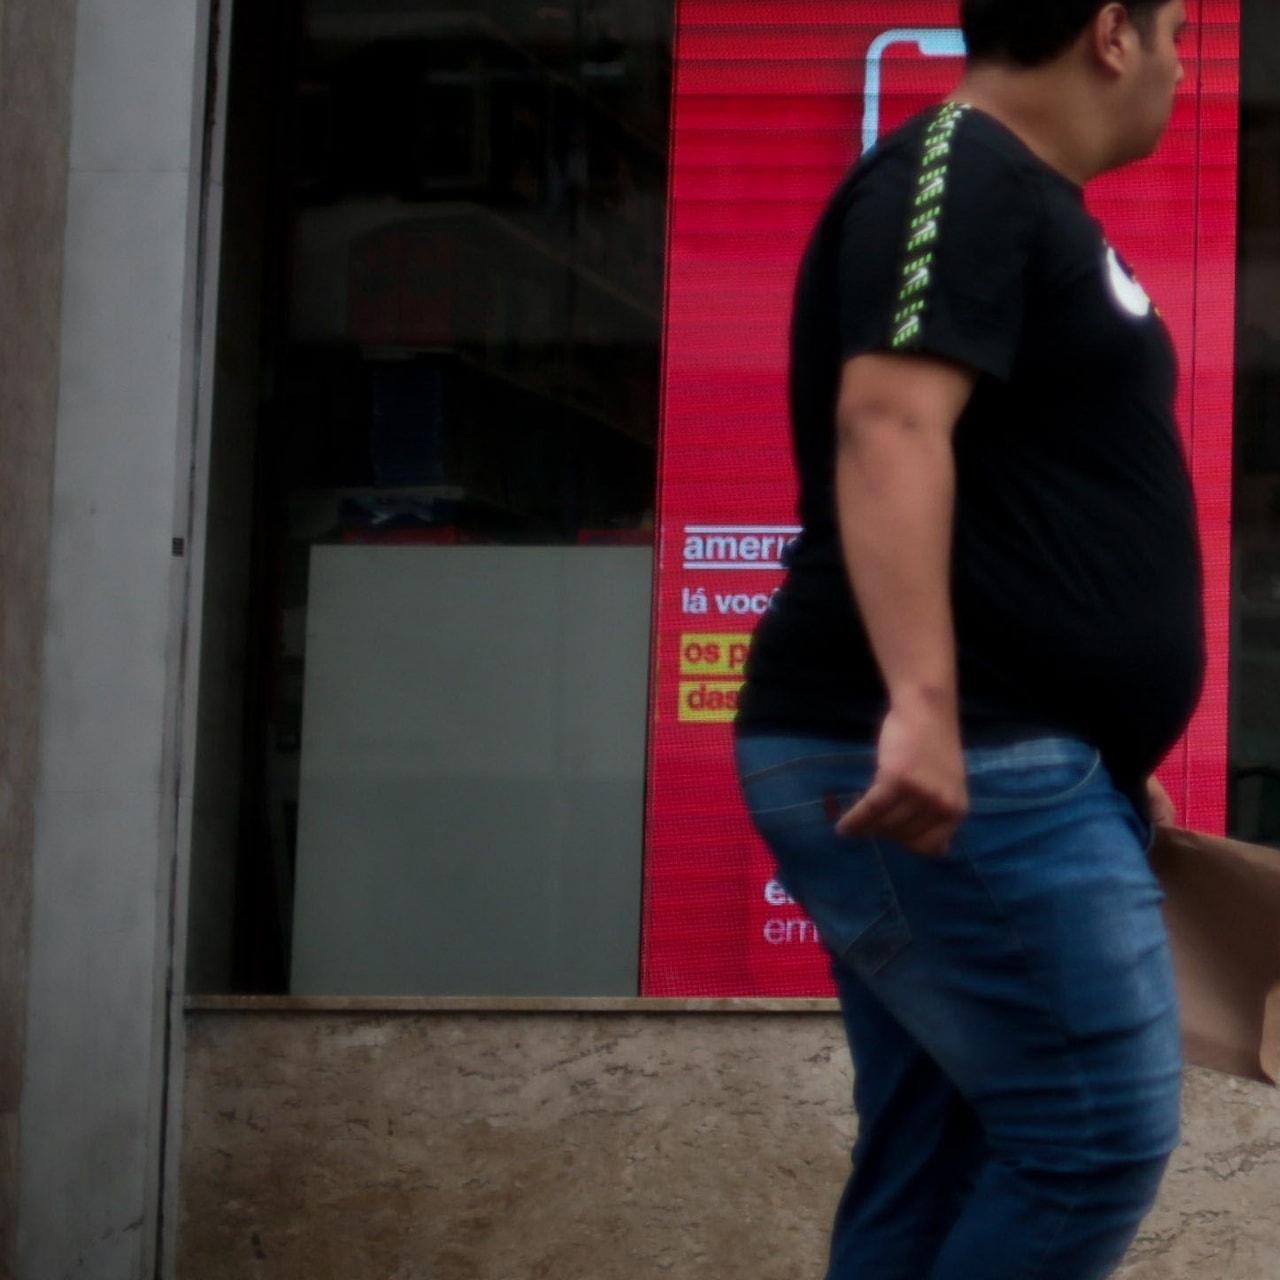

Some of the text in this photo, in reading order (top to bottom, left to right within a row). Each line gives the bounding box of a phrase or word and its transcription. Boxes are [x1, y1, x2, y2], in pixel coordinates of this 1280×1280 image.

[682, 534, 798, 561] ameri
[681, 586, 709, 615] lá
[684, 640, 720, 665] os
